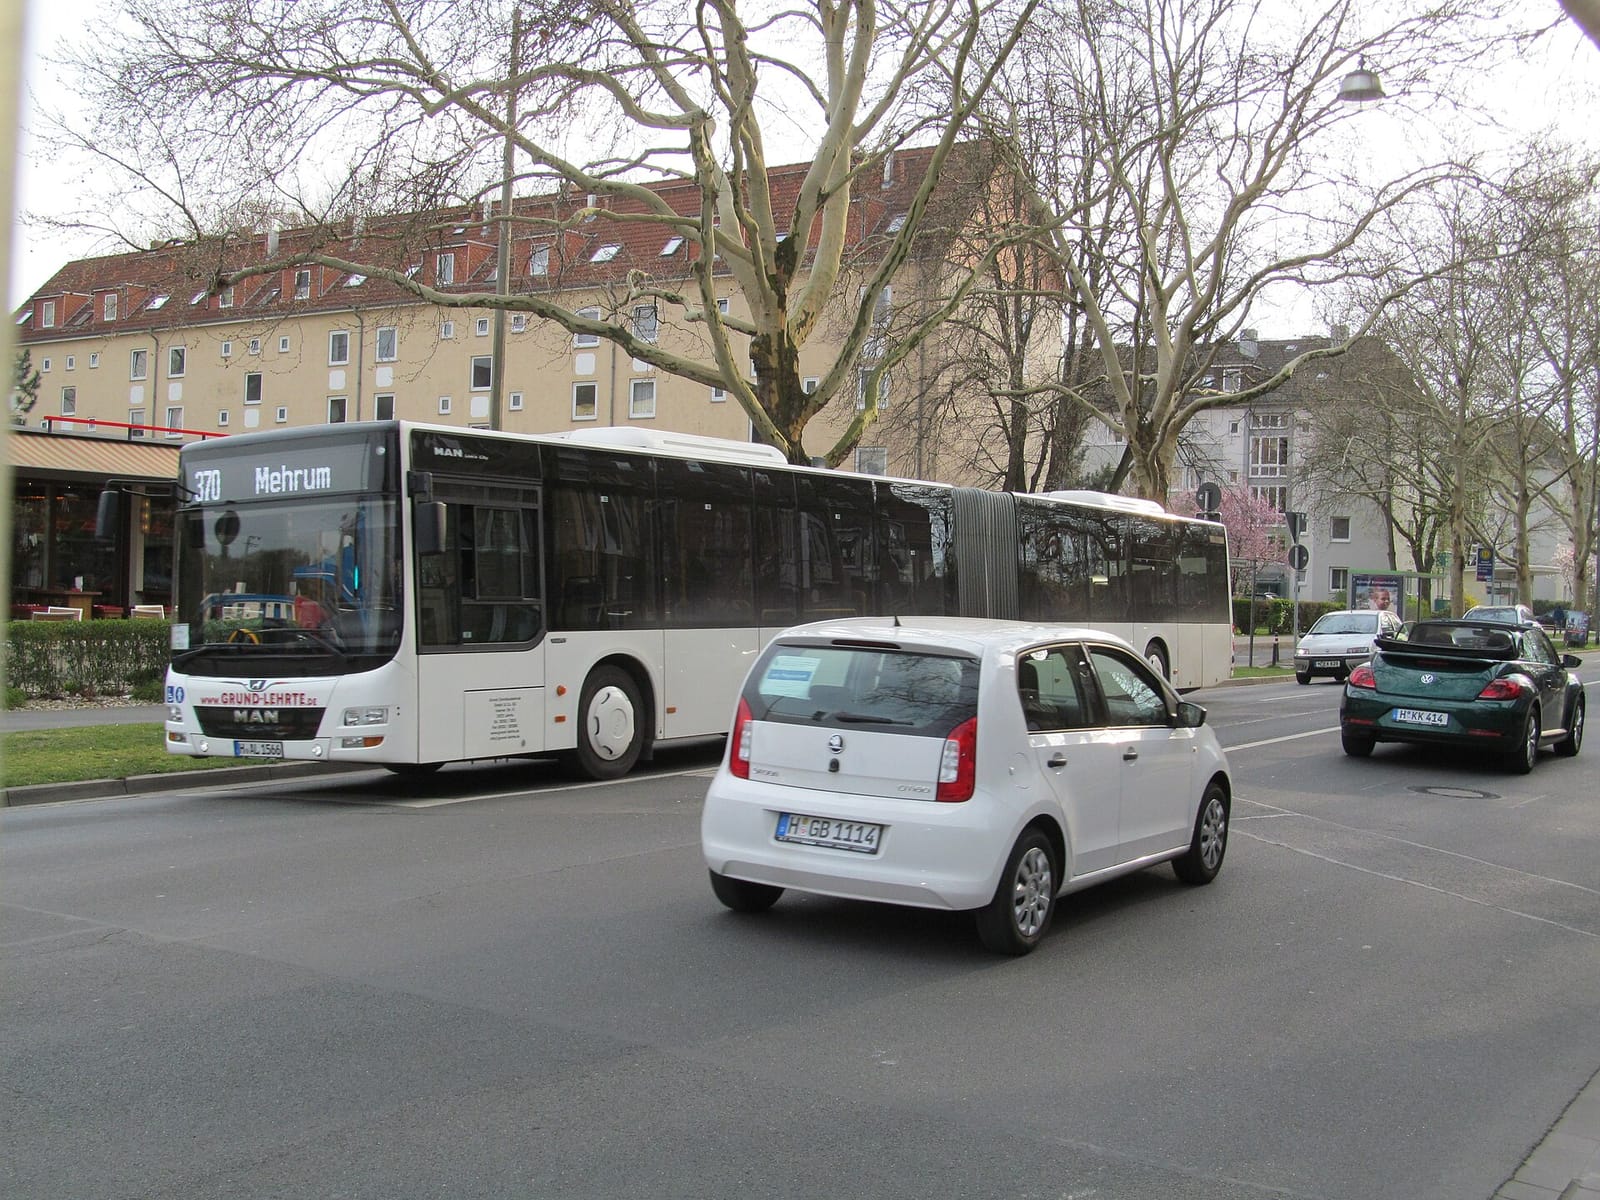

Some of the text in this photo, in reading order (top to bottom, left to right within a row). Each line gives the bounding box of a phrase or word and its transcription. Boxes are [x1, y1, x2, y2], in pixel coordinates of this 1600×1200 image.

[433, 447, 463, 458] MAN
[194, 464, 331, 502] 370 Mehrum
[233, 709, 279, 723] MAN
[1400, 710, 1443, 723] H KK 414
[250, 743, 259, 755] AL
[261, 744, 281, 756] 1566
[788, 816, 876, 845] H GB 1114
